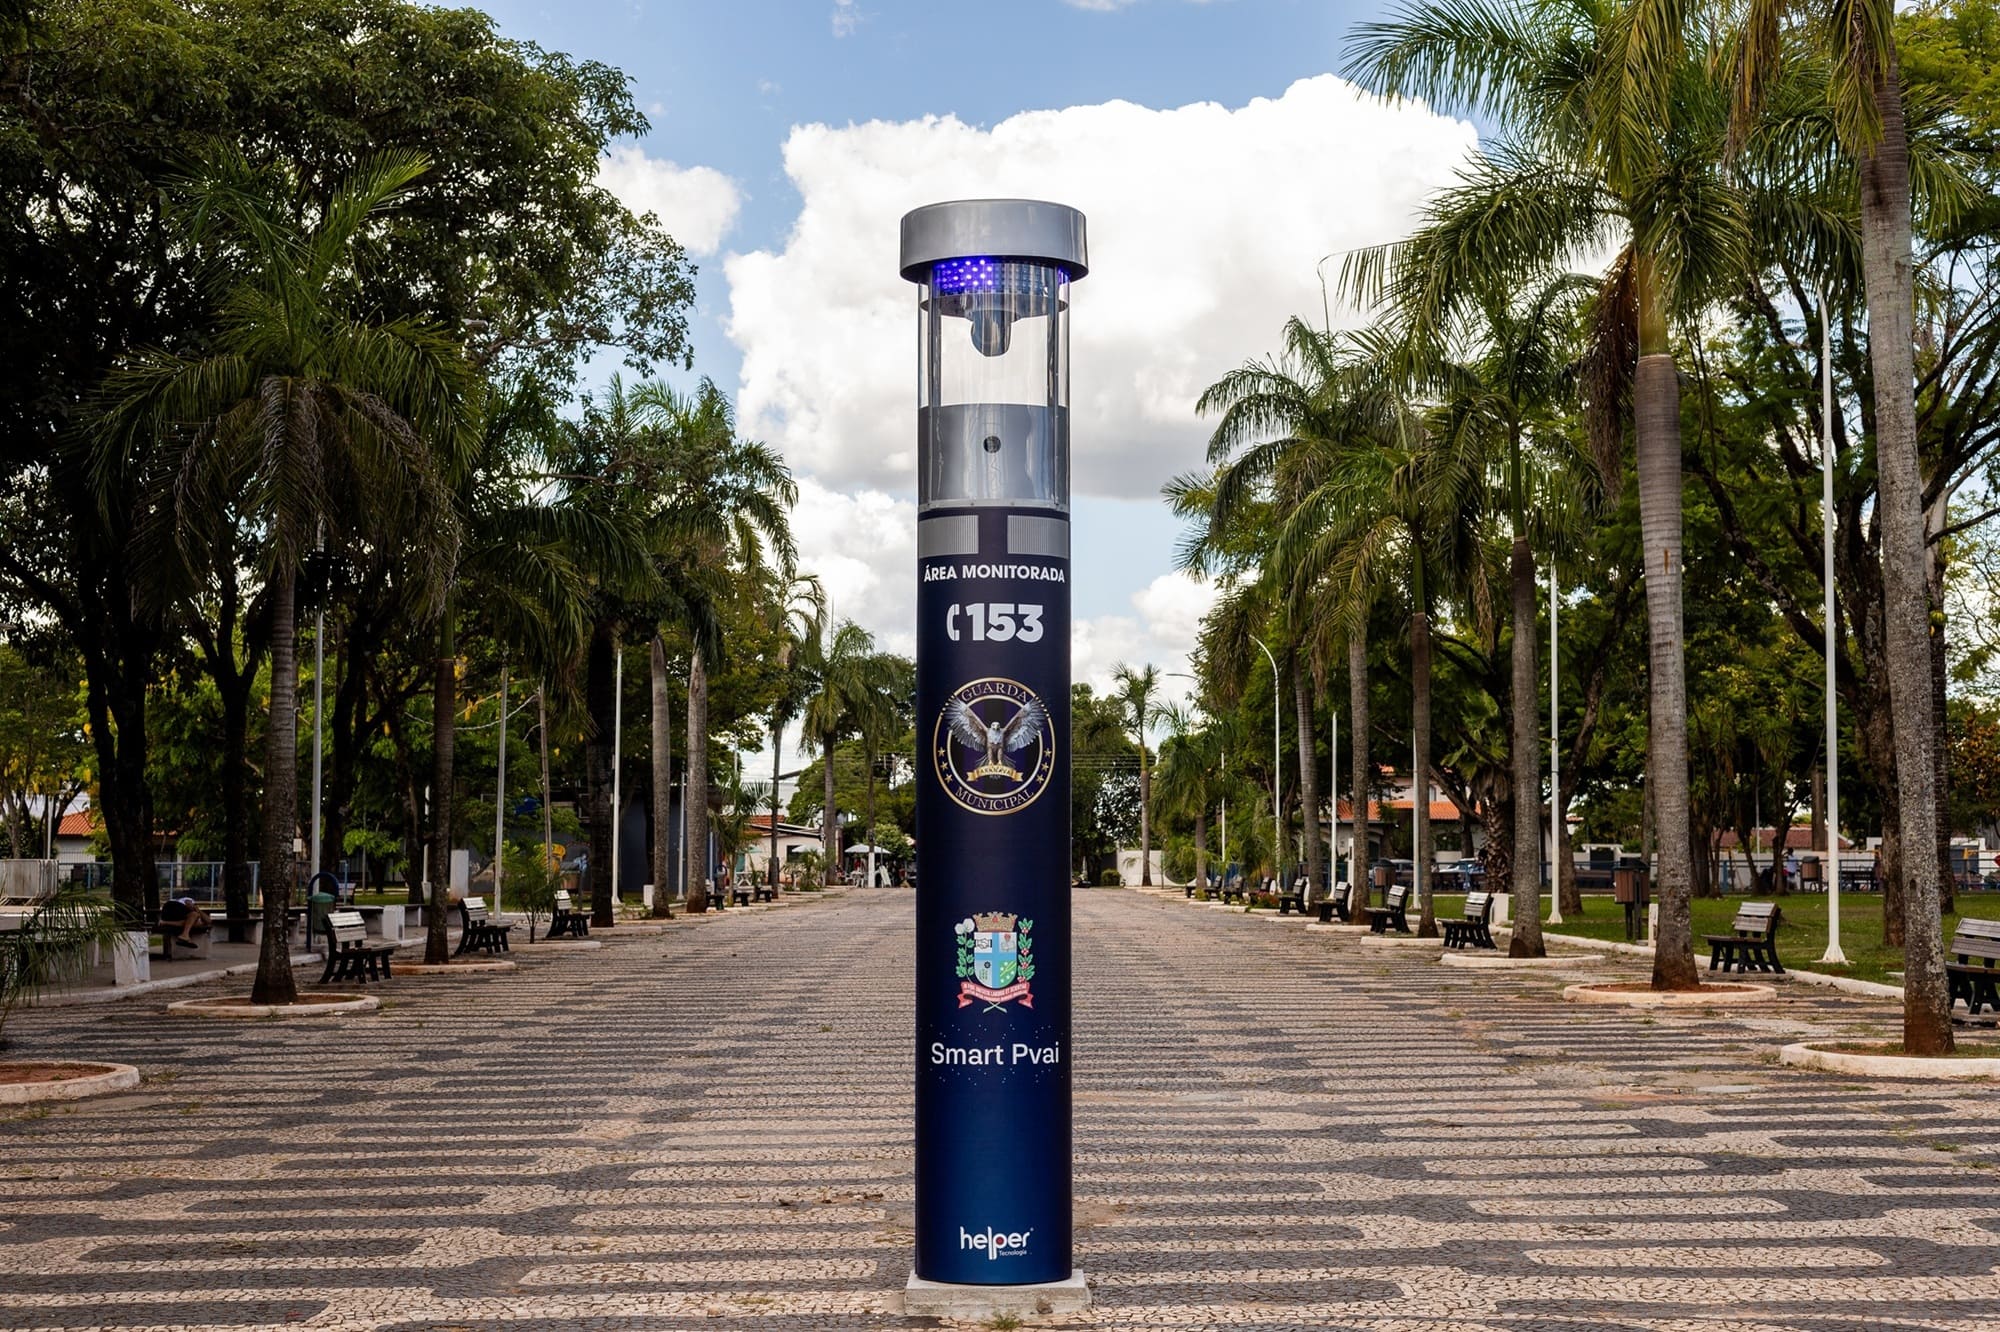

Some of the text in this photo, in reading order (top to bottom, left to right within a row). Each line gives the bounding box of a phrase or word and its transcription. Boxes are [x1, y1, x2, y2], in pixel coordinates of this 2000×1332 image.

[924, 564, 1065, 583] ÁREA MONITORADA
[961, 682, 1028, 702] GUARDA
[955, 786, 1034, 810] MUNICIPAL
[931, 1041, 1059, 1065] Smart Pvai
[960, 1225, 1031, 1260] helper
